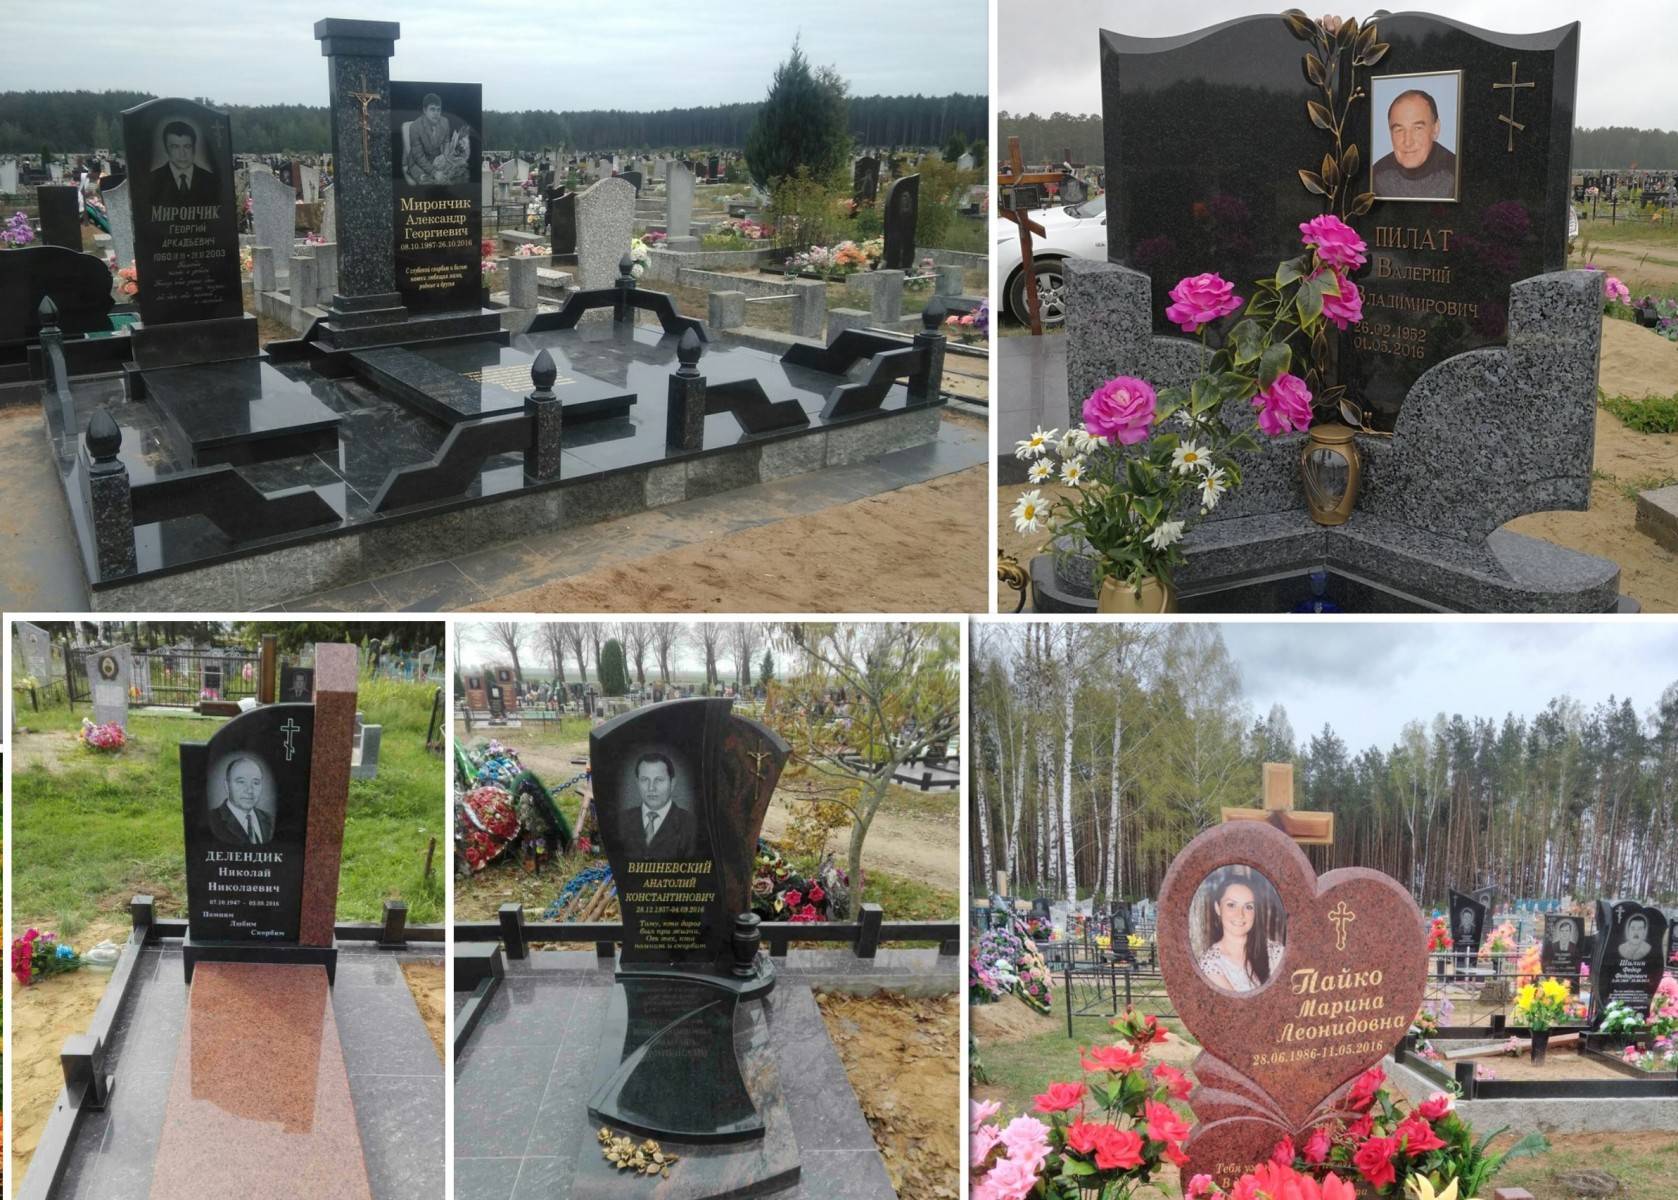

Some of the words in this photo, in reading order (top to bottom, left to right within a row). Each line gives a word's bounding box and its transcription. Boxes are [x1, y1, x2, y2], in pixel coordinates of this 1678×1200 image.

[400, 197, 471, 213] Мирончик
[151, 205, 223, 222] МИРОНЧИК
[405, 214, 467, 225] Александр
[405, 227, 468, 240] Георгиевич
[1376, 226, 1454, 252] ПИЛАТ
[1377, 256, 1451, 284] ВАЛЕРИЙ
[205, 850, 284, 863] ДЕЛЕНДИК
[218, 866, 271, 878] Николай
[628, 860, 712, 874] ВИШНЕВСКИЙ
[208, 881, 280, 893] Николаевич
[642, 876, 697, 888] АНАТОЛИЙ
[625, 892, 715, 902] КОНСТАНТИНОВИЧ
[1291, 967, 1383, 995] Пайко
[1294, 995, 1385, 1019] Марина
[1276, 1015, 1406, 1043] Леонидовна
[1252, 1040, 1384, 1067] 28.06.1986-11.05.2016
[1215, 1162, 1241, 1174] Тебя
